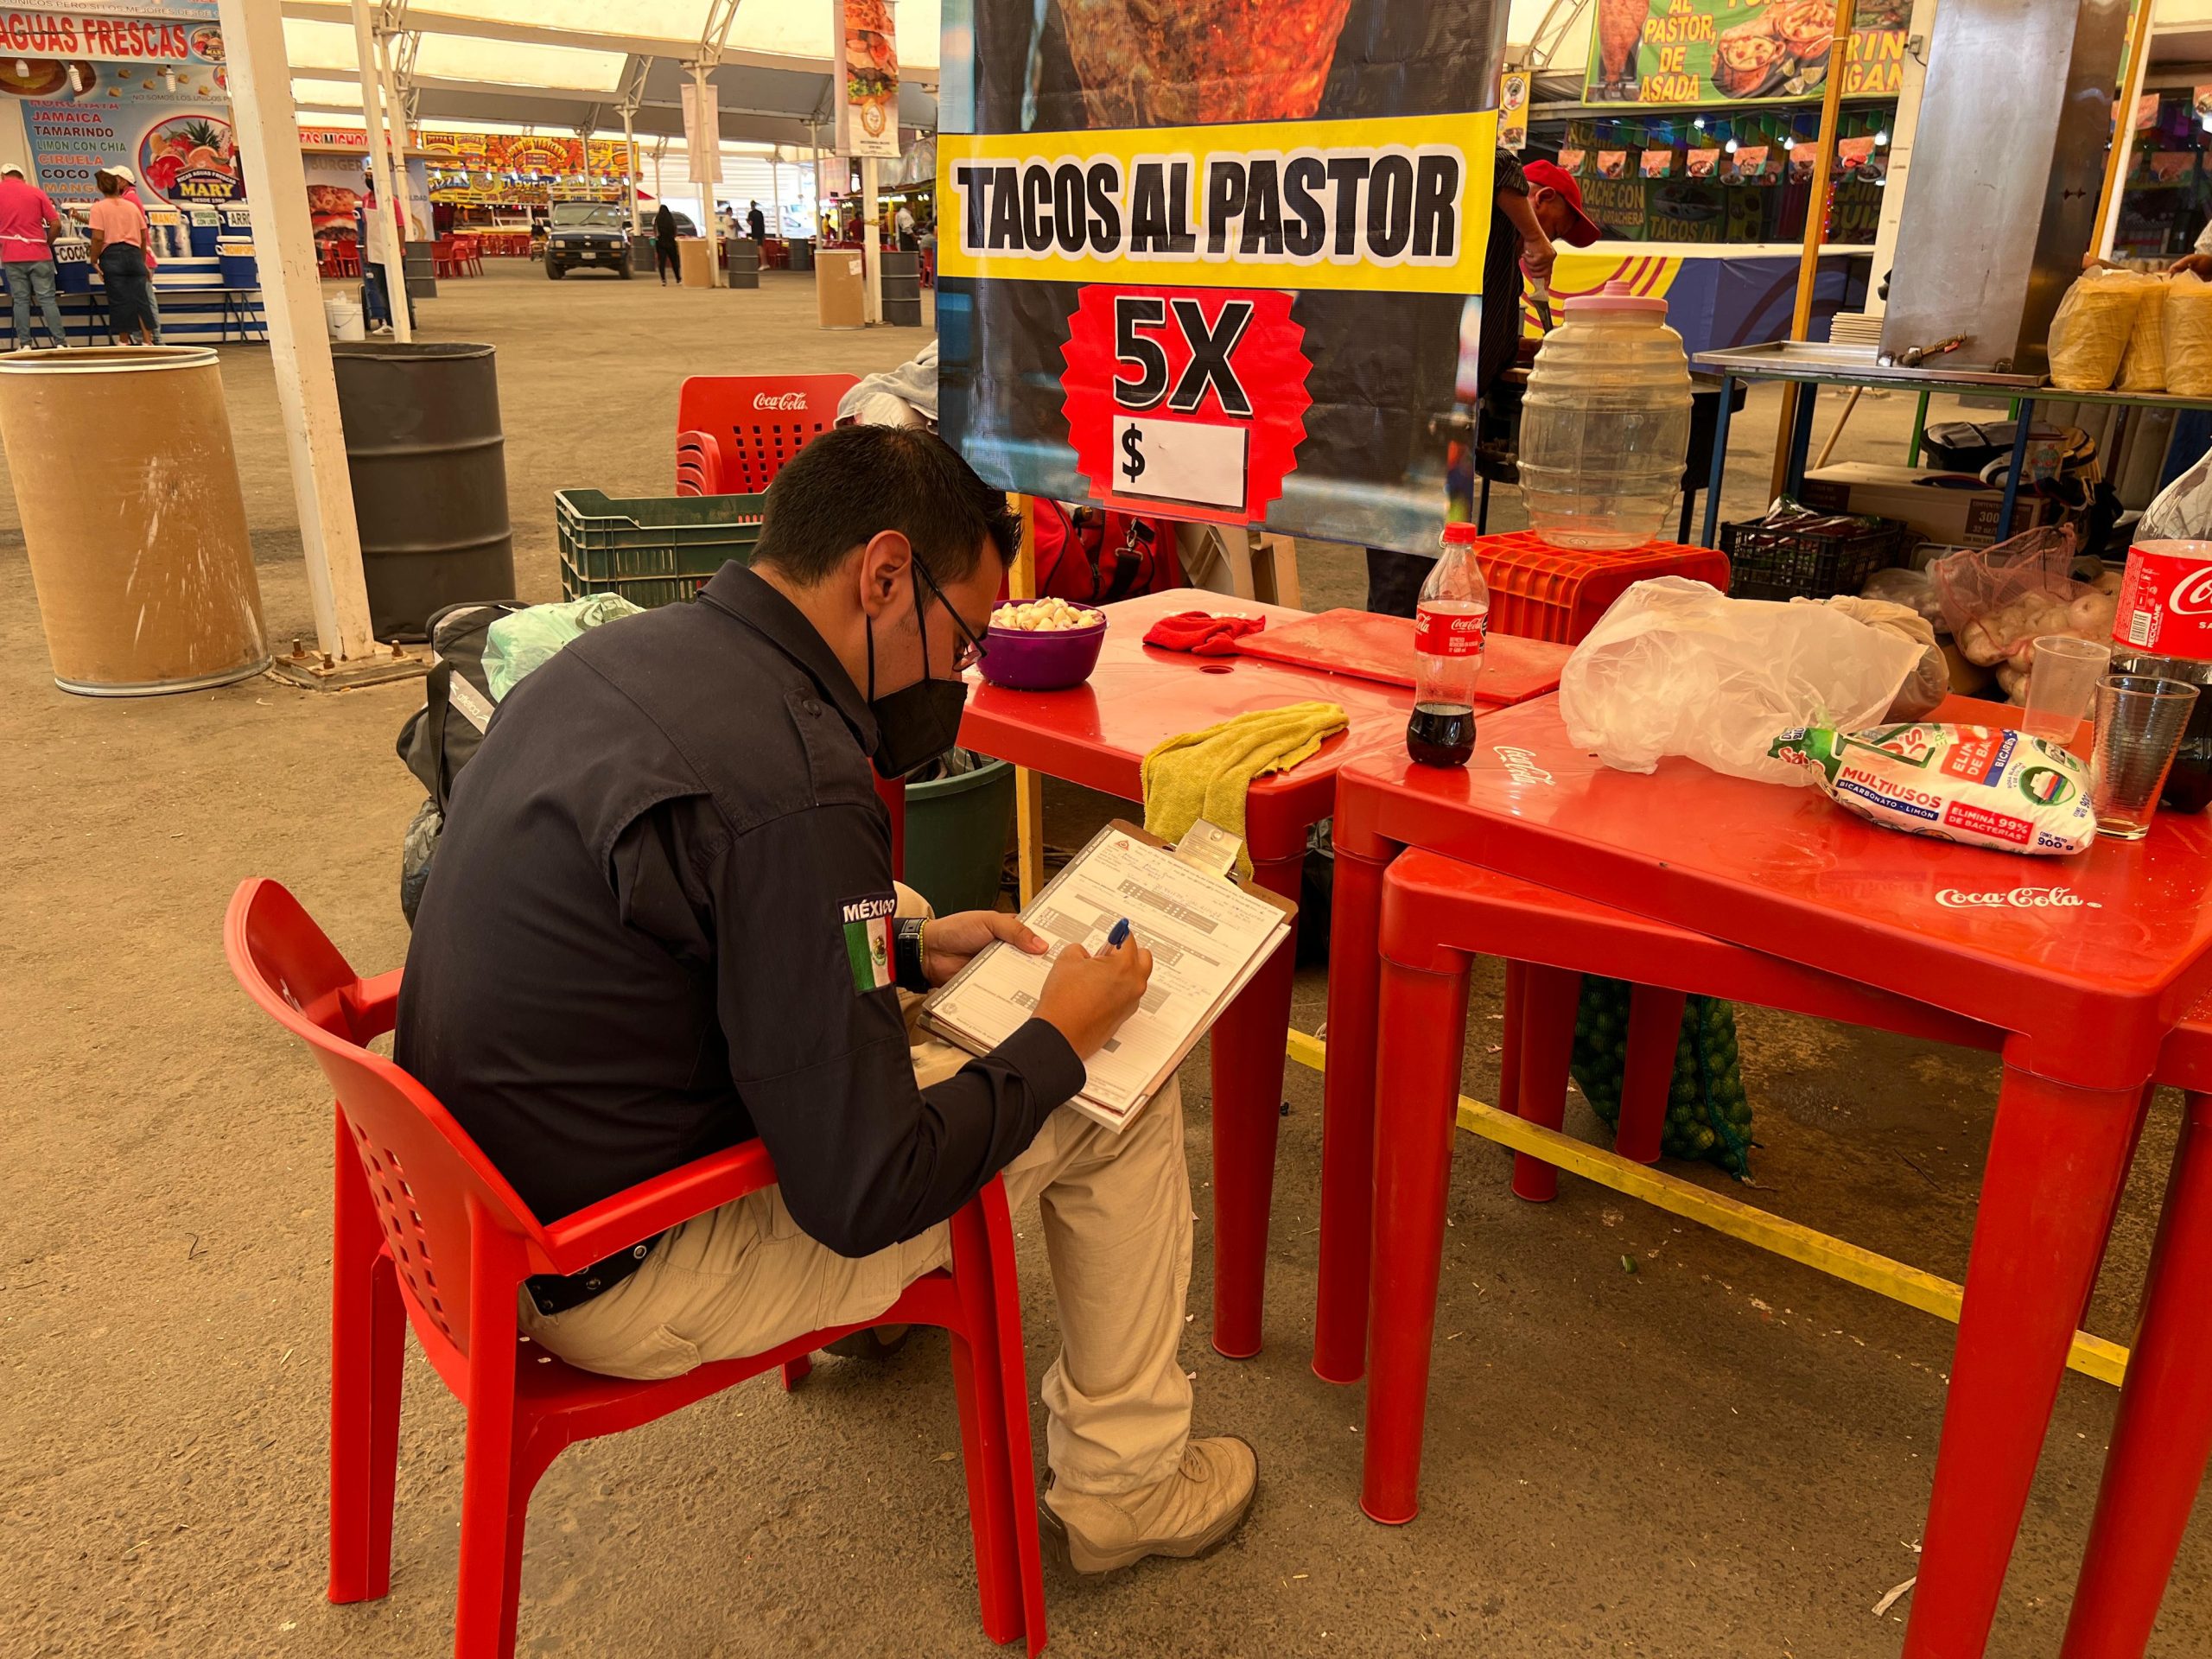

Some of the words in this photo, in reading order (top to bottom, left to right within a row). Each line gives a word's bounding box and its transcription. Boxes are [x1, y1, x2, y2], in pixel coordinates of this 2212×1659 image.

[0, 13, 79, 54] AGUAS
[82, 18, 189, 59] FRESCAS
[1643, 14, 1717, 45] PASTOR,
[1845, 30, 1907, 62] RIN
[1658, 47, 1687, 73] DE
[1639, 73, 1700, 103] ASADA
[32, 111, 102, 123] JAMAICA
[34, 126, 114, 137] TAMARINDO
[37, 140, 69, 150] LIMON
[73, 141, 97, 151] CON
[100, 142, 126, 152] CHIA
[38, 154, 104, 165] CIRUELA
[311, 157, 364, 172] BURGER
[41, 169, 90, 179] COCO
[180, 182, 234, 197] MARY
[1618, 184, 1645, 209] CON
[957, 162, 1122, 253] TACOS
[1130, 162, 1196, 253] AL
[1207, 155, 1459, 257] PASTOR
[1649, 215, 1699, 243] TACOS
[1114, 296, 1255, 418] 5X
[753, 392, 808, 410] Coca-Cola
[1122, 423, 1146, 482] $
[1452, 618, 1482, 631] Coca-Cola
[2147, 604, 2163, 648] RECICLAME
[1493, 746, 1556, 785] Coca-Cola
[1952, 741, 1975, 772] ELIM
[1967, 759, 1981, 776] DE
[1839, 781, 1898, 809] BICARBONATO
[1905, 804, 1935, 819] LIMÓN
[1841, 766, 1943, 810] MULTIUSOS
[1948, 815, 1963, 825] DE
[1951, 807, 1996, 826] ELIMINA
[1998, 817, 2028, 834] 99%
[2037, 837, 2063, 849] 900
[2054, 835, 2068, 843] NETO
[1074, 851, 1089, 865] INFORME
[1935, 887, 2083, 908] Coca-Cola
[843, 899, 895, 923] MÉXICO
